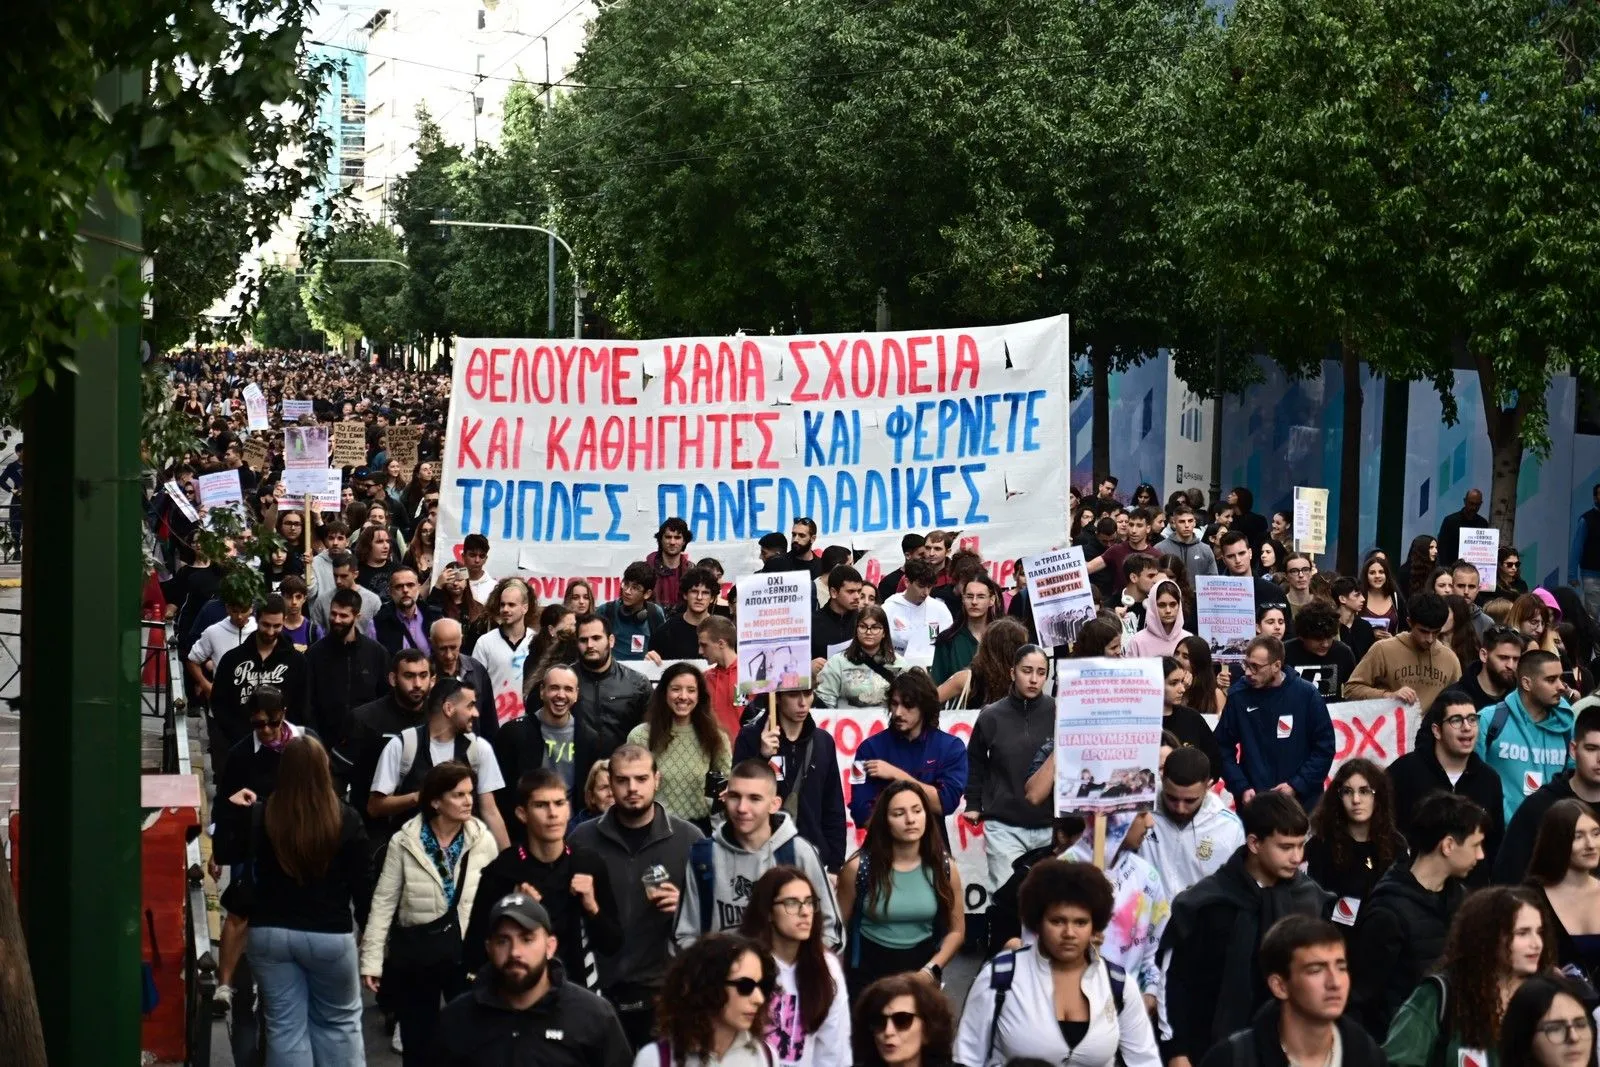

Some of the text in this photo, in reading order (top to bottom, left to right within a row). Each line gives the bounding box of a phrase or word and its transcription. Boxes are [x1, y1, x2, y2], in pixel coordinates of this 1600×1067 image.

[465, 334, 980, 405] ΘΕΛΟΥΜΕ ΚΑΛΑ ΣΧΟΛΕΙΑ
[457, 416, 524, 469] ΚΑΙ
[546, 412, 780, 472] ΚΑΘΗΓΗΤΕΣ
[803, 409, 861, 467] ΚΑΙ
[885, 389, 1047, 464] ΦΕΡΝΕΤΕ
[456, 462, 989, 543] ΤΡΙΠΛΕΣ ΠΑΝΕΛΛΑΔΙΚΕΣ
[1028, 559, 1082, 578] ΠΑΝΕΛΛΑΔΙΚΕΣ
[1041, 552, 1071, 566] ΤΡΙΠΛΕΣ
[767, 576, 784, 586] ΟΧΙ
[1045, 571, 1080, 586] ΜΕΙΝΟΥΝ
[1051, 581, 1083, 595] ΧΑΡΤΙΑ!
[1394, 664, 1448, 684] COLUMBIA
[1498, 742, 1567, 766] ZOO YORK
